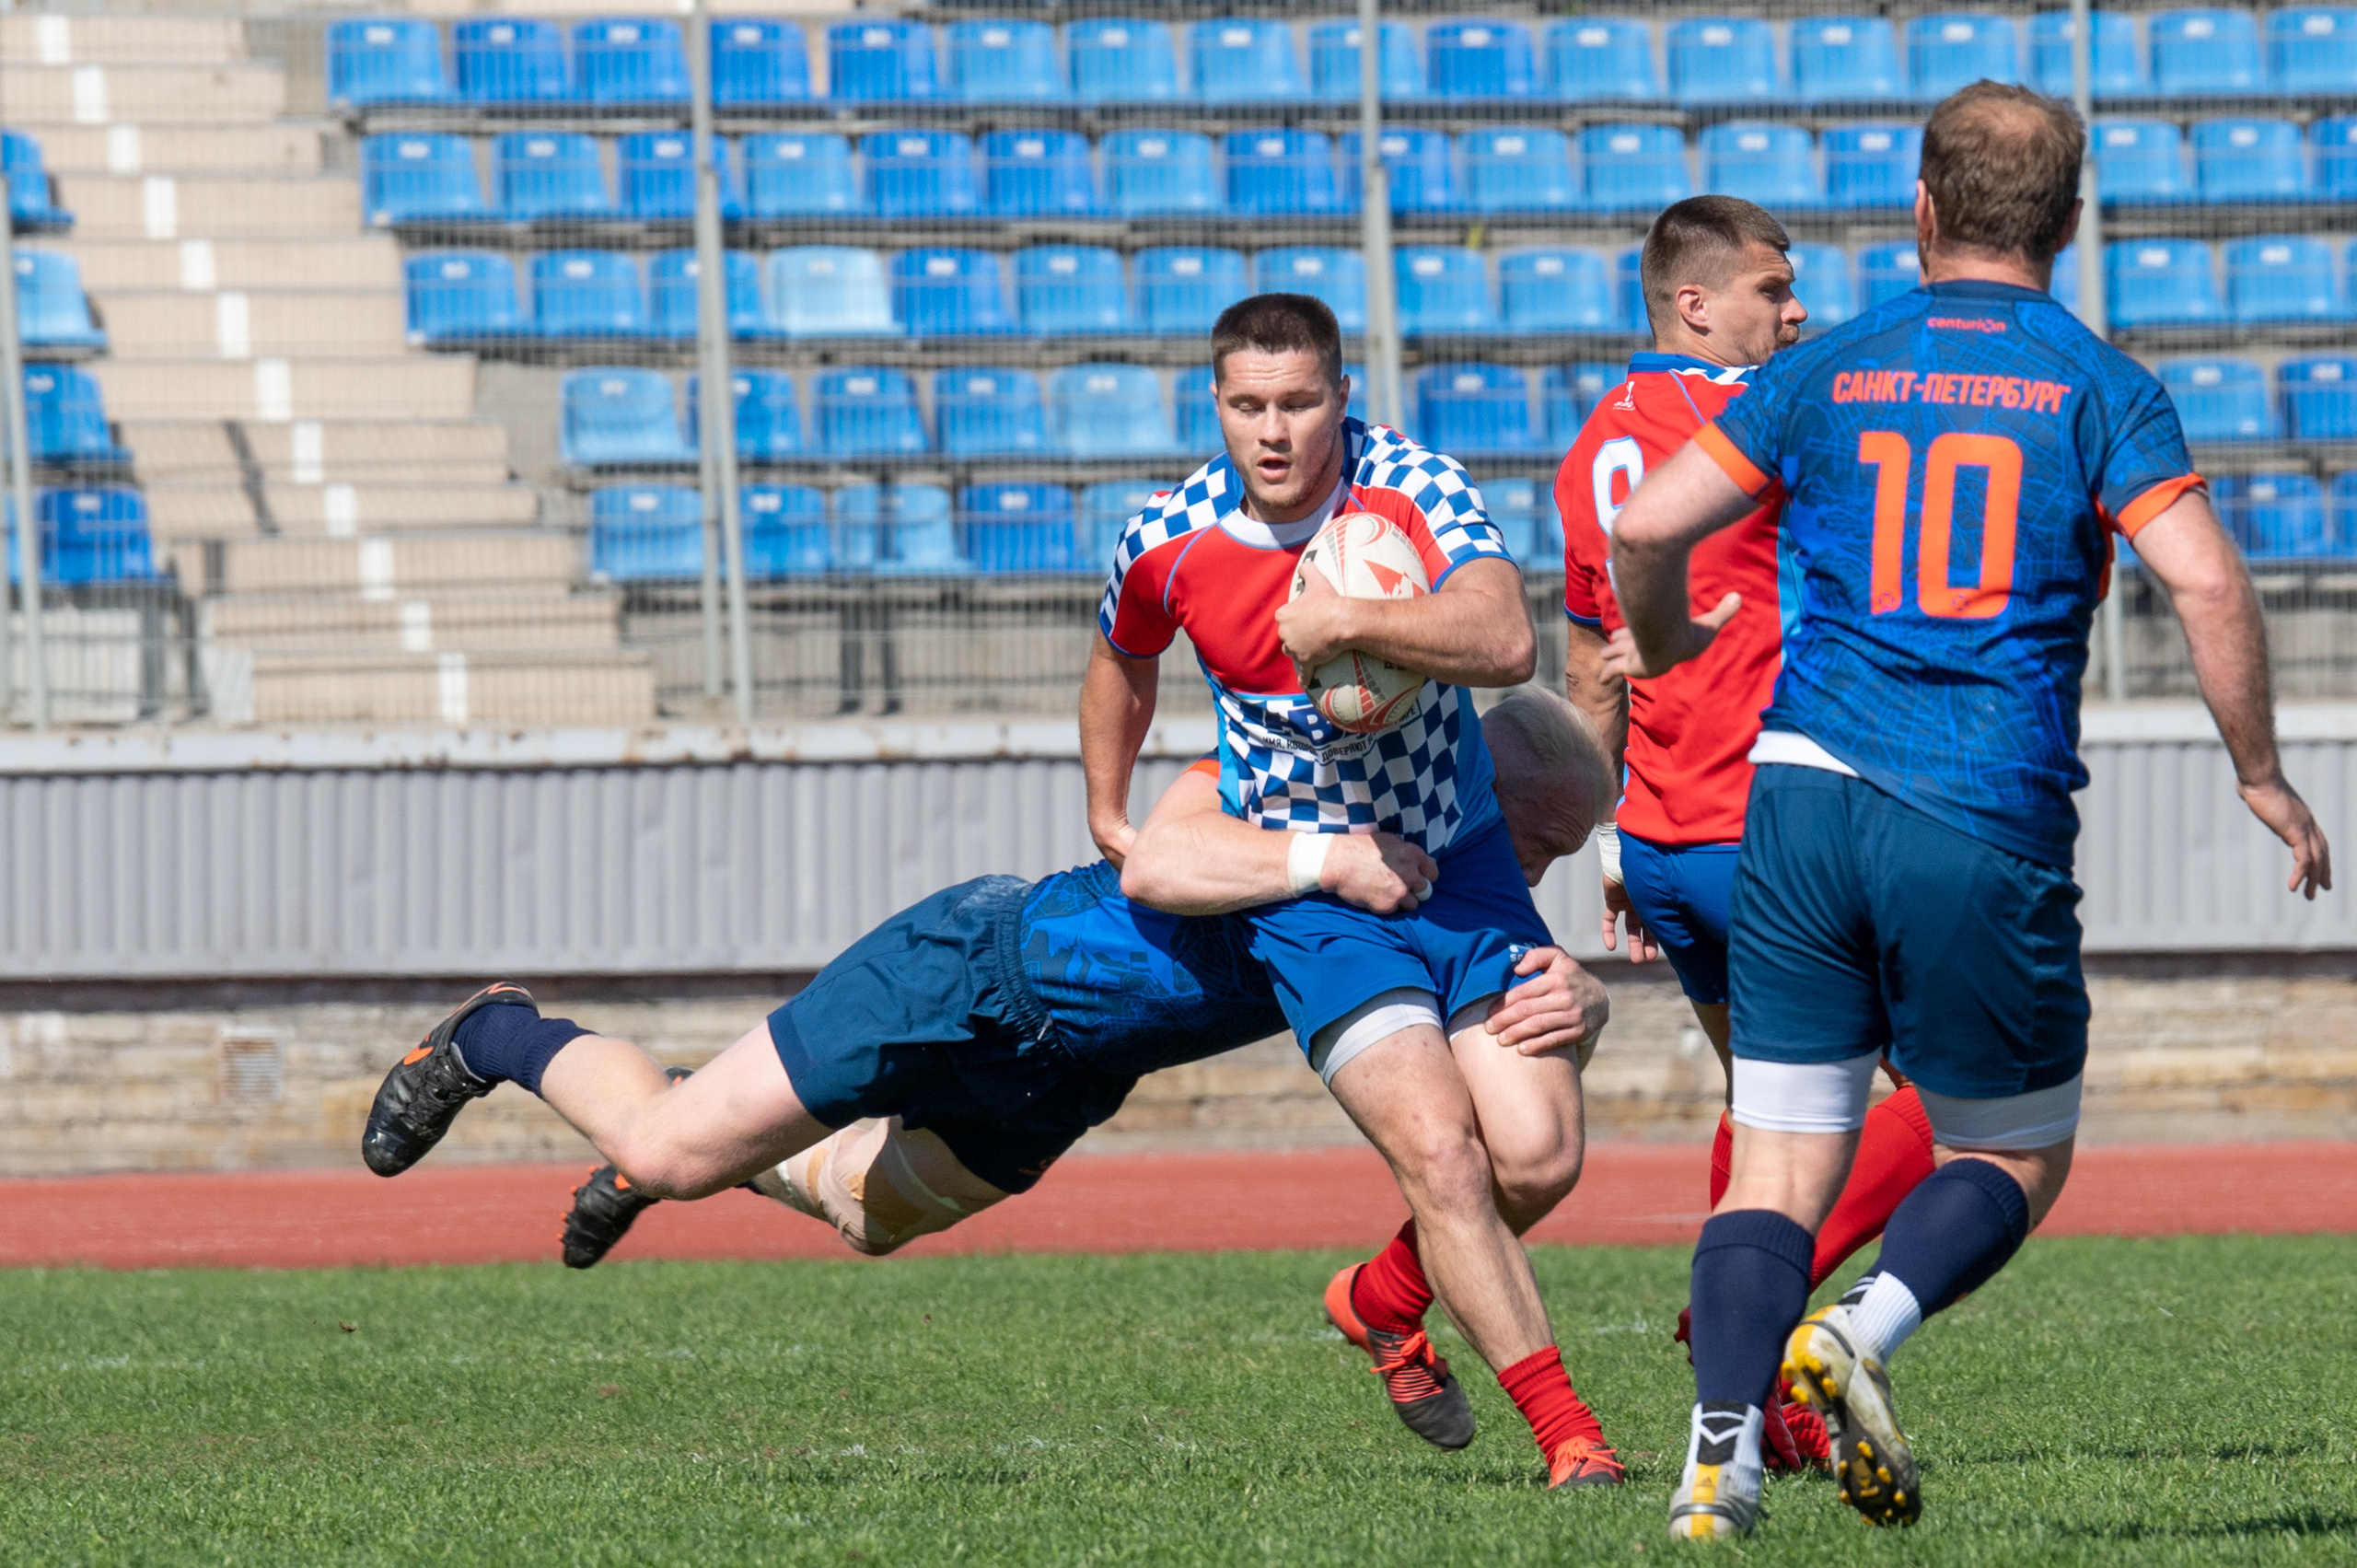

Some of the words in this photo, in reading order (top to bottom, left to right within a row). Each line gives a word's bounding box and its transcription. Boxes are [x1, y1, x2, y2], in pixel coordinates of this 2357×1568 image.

[1832, 370, 2072, 414] САНКТ-ПЕТЕРБУРГ
[1859, 431, 2023, 620] 10
[1321, 739, 1368, 762] ДОВЕРЯЮТ
